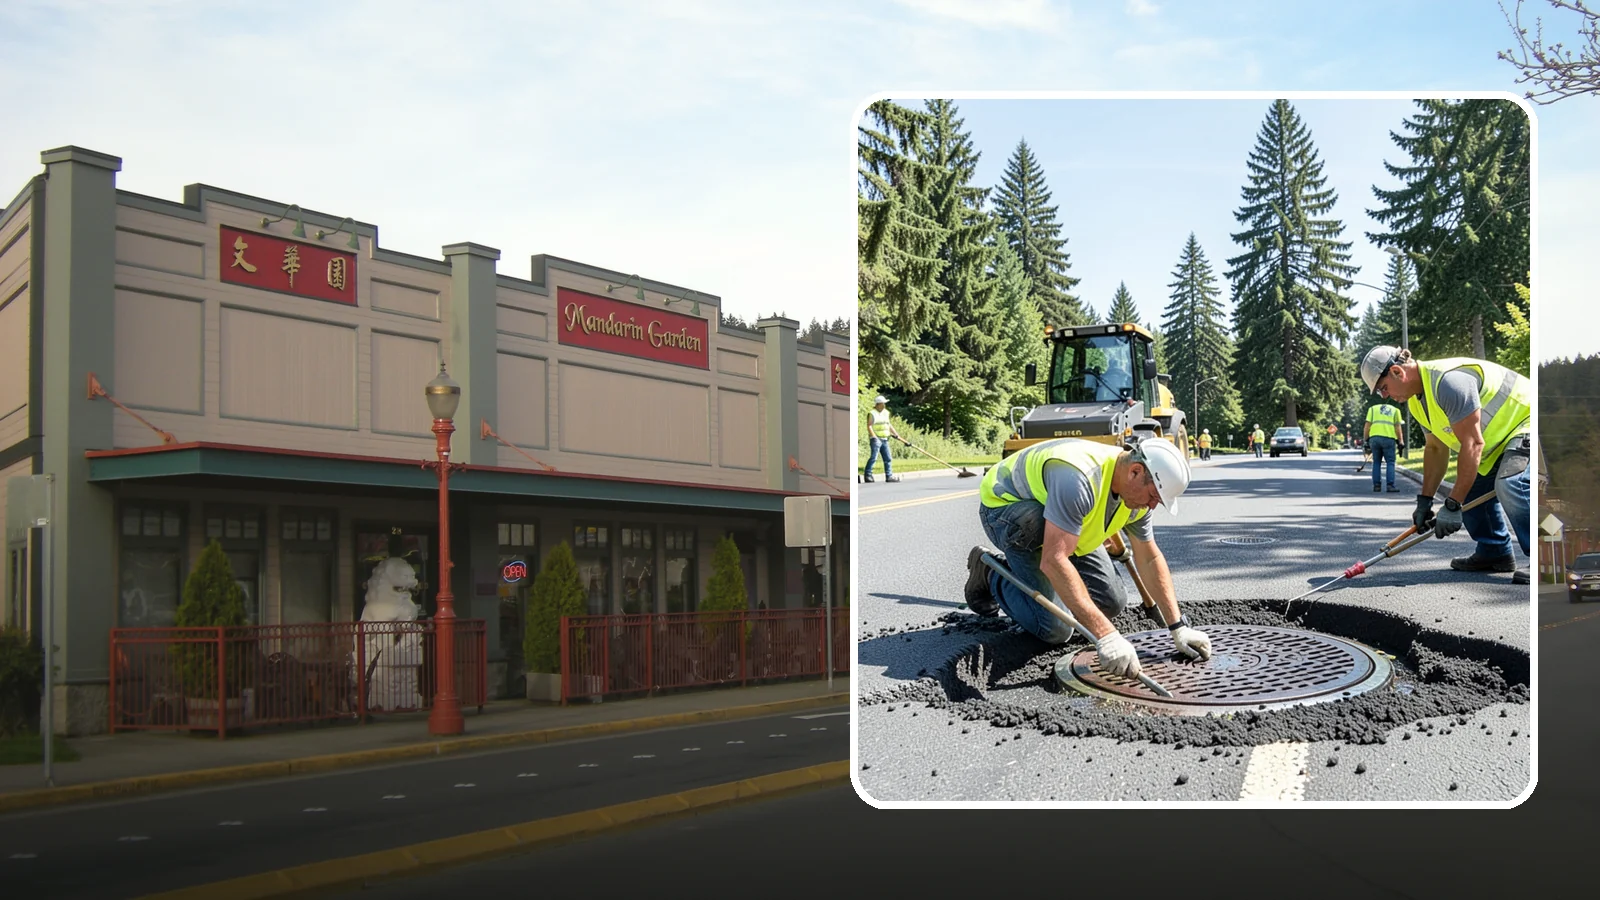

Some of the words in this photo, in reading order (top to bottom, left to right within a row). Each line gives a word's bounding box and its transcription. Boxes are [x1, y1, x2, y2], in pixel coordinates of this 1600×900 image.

[230, 235, 346, 290] 文華園
[564, 302, 644, 341] Mandarin
[647, 320, 701, 352] Garden
[503, 565, 527, 578] OPEN
